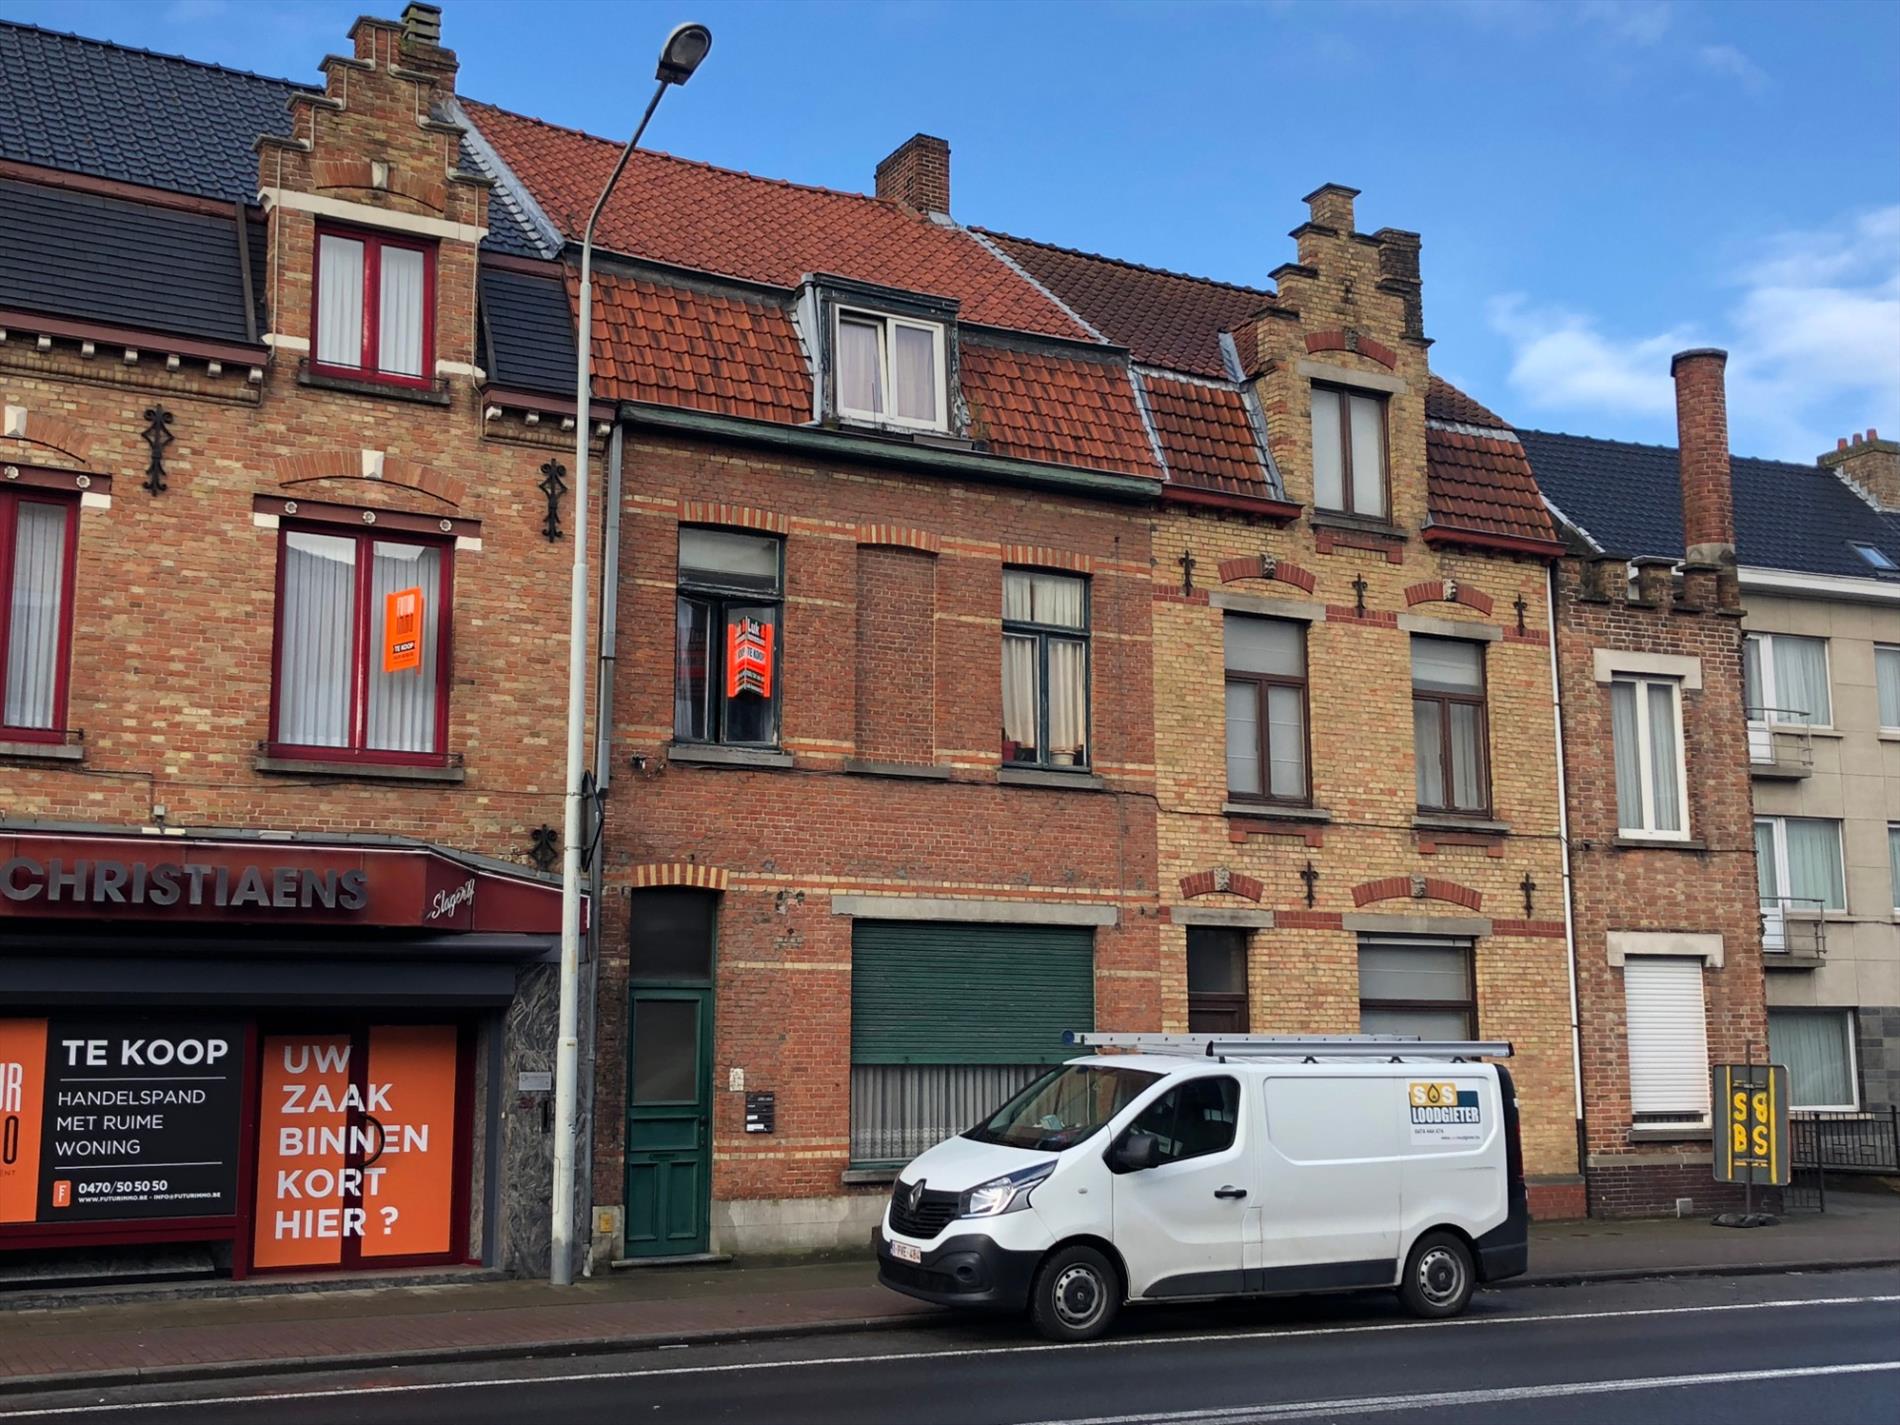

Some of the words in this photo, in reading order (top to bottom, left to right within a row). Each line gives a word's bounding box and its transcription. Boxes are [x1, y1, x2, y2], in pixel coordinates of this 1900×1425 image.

[0, 856, 369, 910] CHRISTIAENS
[62, 1039, 109, 1066] TE
[121, 1038, 229, 1066] KOOP
[283, 1045, 353, 1074] UW
[58, 1089, 207, 1107] HANDELSPAND
[280, 1083, 393, 1114] ZAAK
[56, 1116, 98, 1132] MET
[103, 1114, 164, 1130] RUIME
[1412, 1106, 1479, 1123] LOODGIETER
[55, 1139, 142, 1157] WONING
[278, 1124, 429, 1156] BINNEN
[78, 1194, 148, 1204] WWW.FUTURIMMO.BE
[153, 1191, 221, 1201] INFO@FUTURIMMO.BE
[276, 1167, 387, 1200] KORT
[274, 1207, 367, 1240] HIER
[379, 1205, 399, 1235] ?
